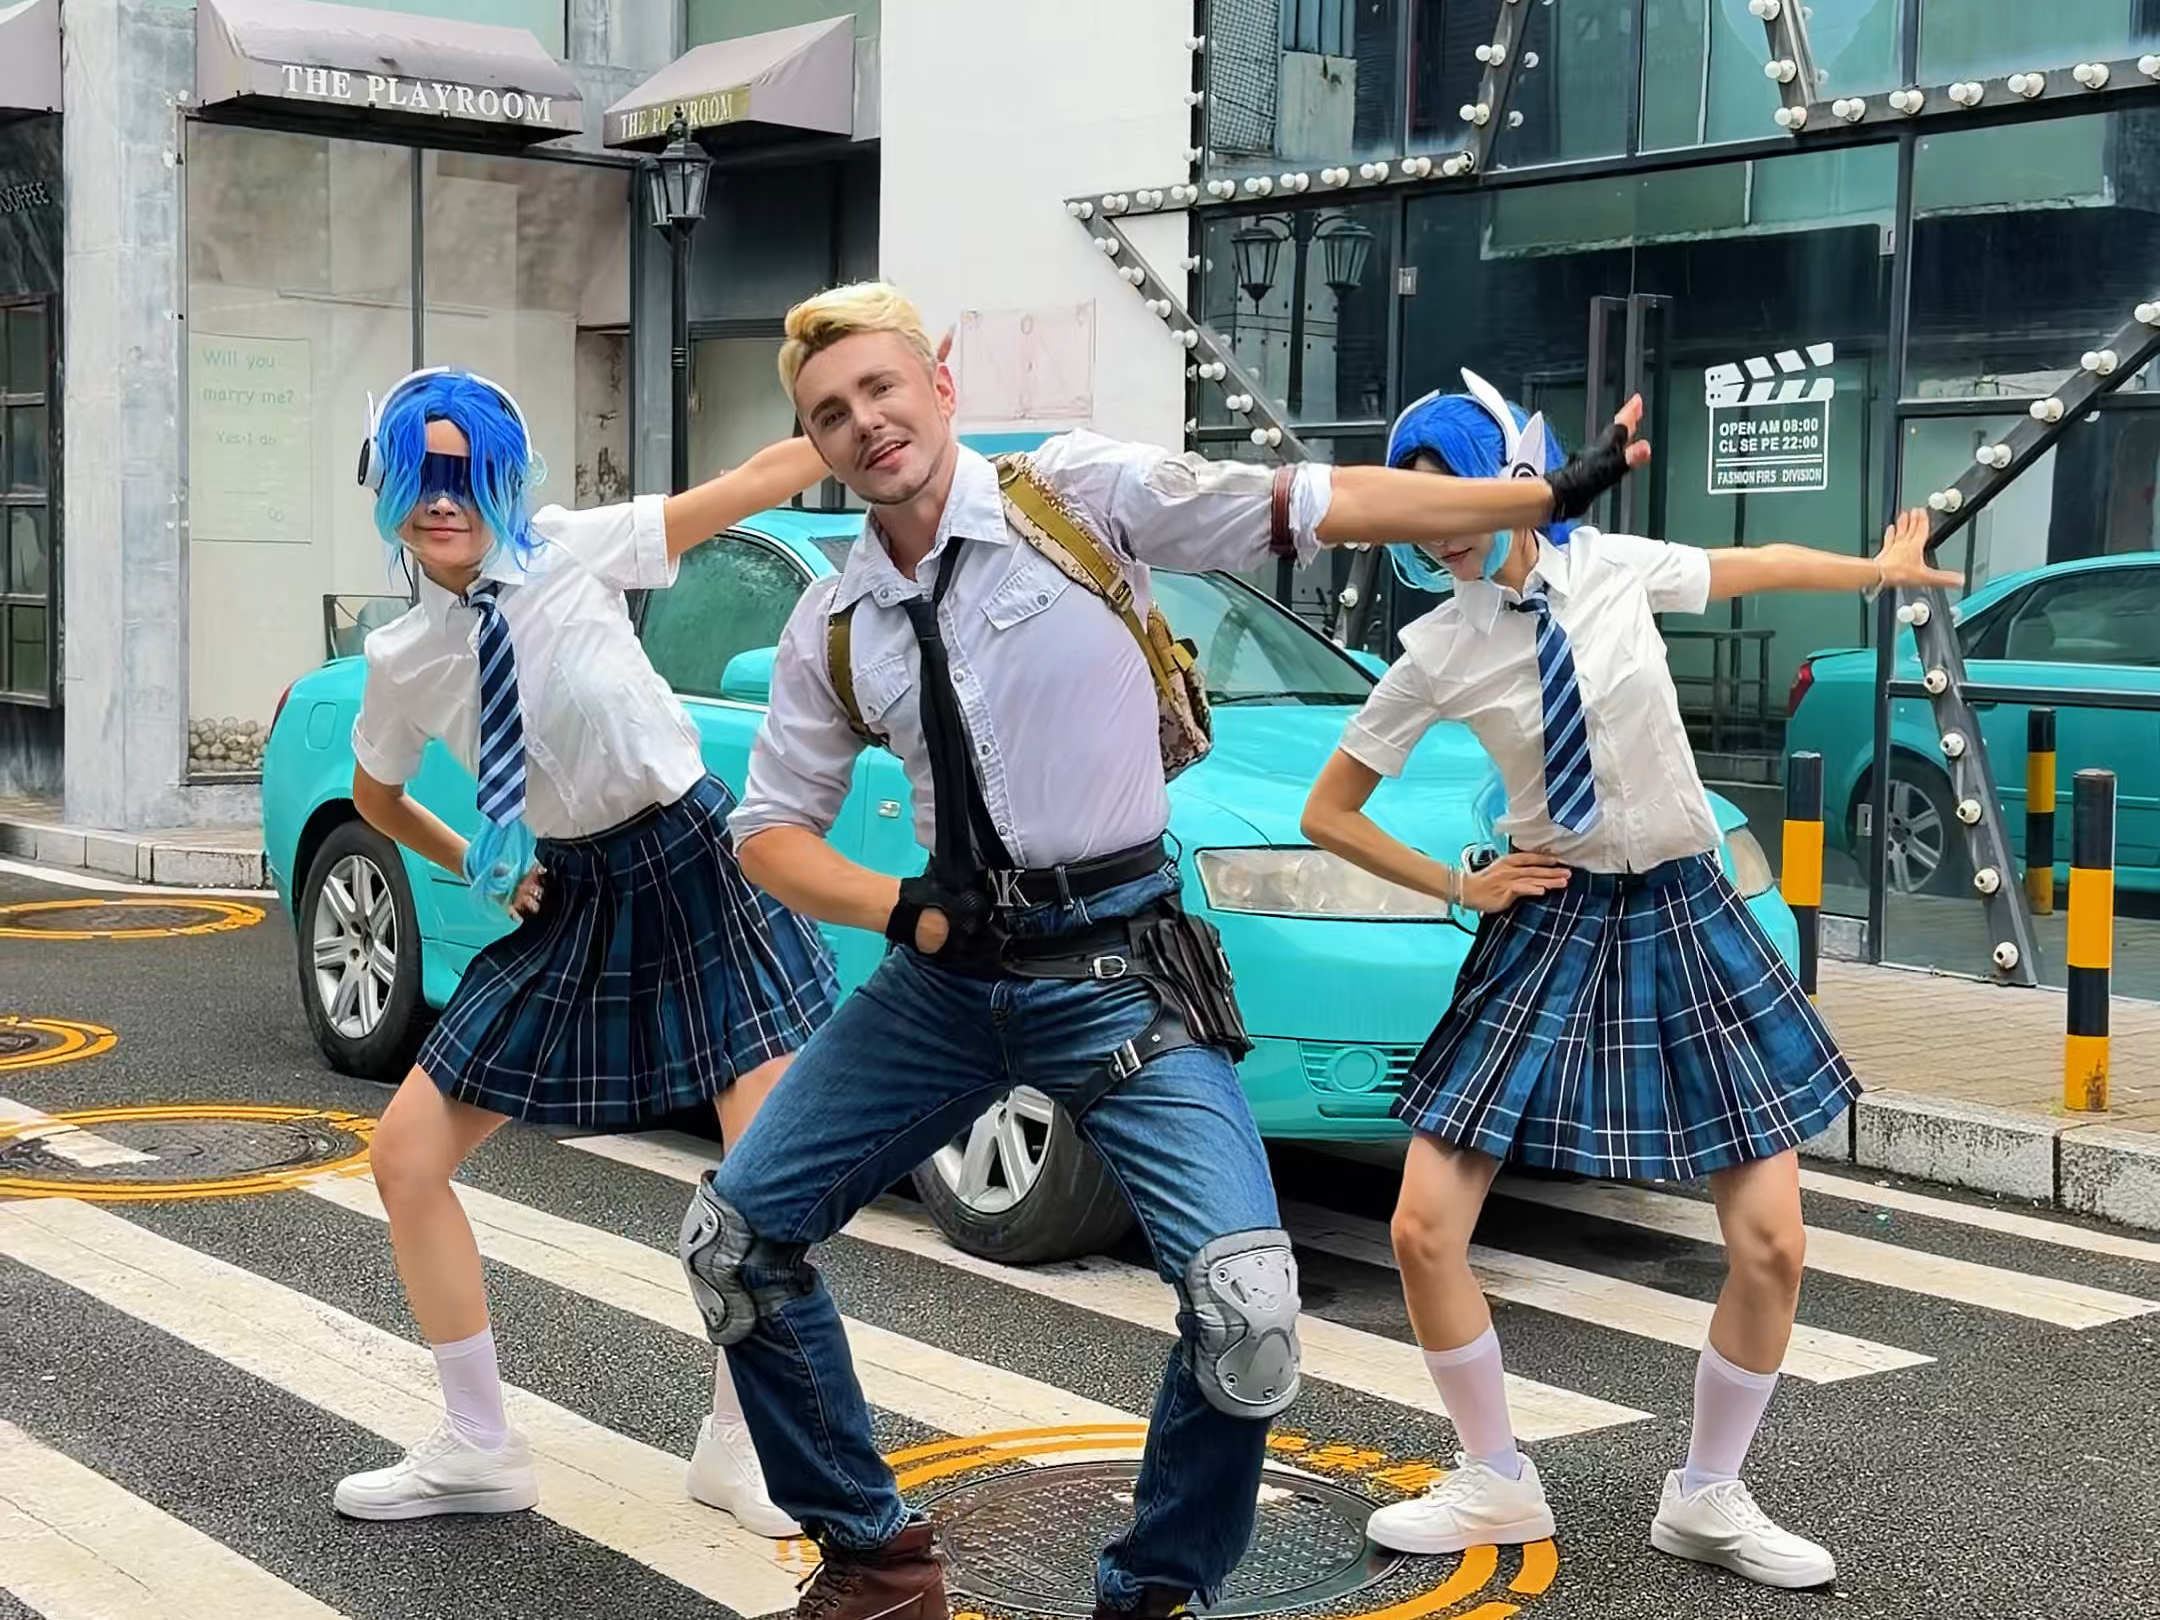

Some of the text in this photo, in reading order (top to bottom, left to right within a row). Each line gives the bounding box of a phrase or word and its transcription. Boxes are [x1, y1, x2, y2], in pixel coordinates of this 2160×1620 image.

[282, 65, 552, 122] THE PLAYROOM
[620, 93, 733, 139] THE PLYROOM
[201, 348, 274, 371] Will you
[203, 388, 294, 406] marry me?
[1719, 417, 1819, 437] OPEN AM 08:00
[1760, 437, 1779, 451] PE
[1781, 435, 1818, 450] 22:00
[1717, 470, 1755, 485] FASHION
[1782, 467, 1822, 482] DIVISION
